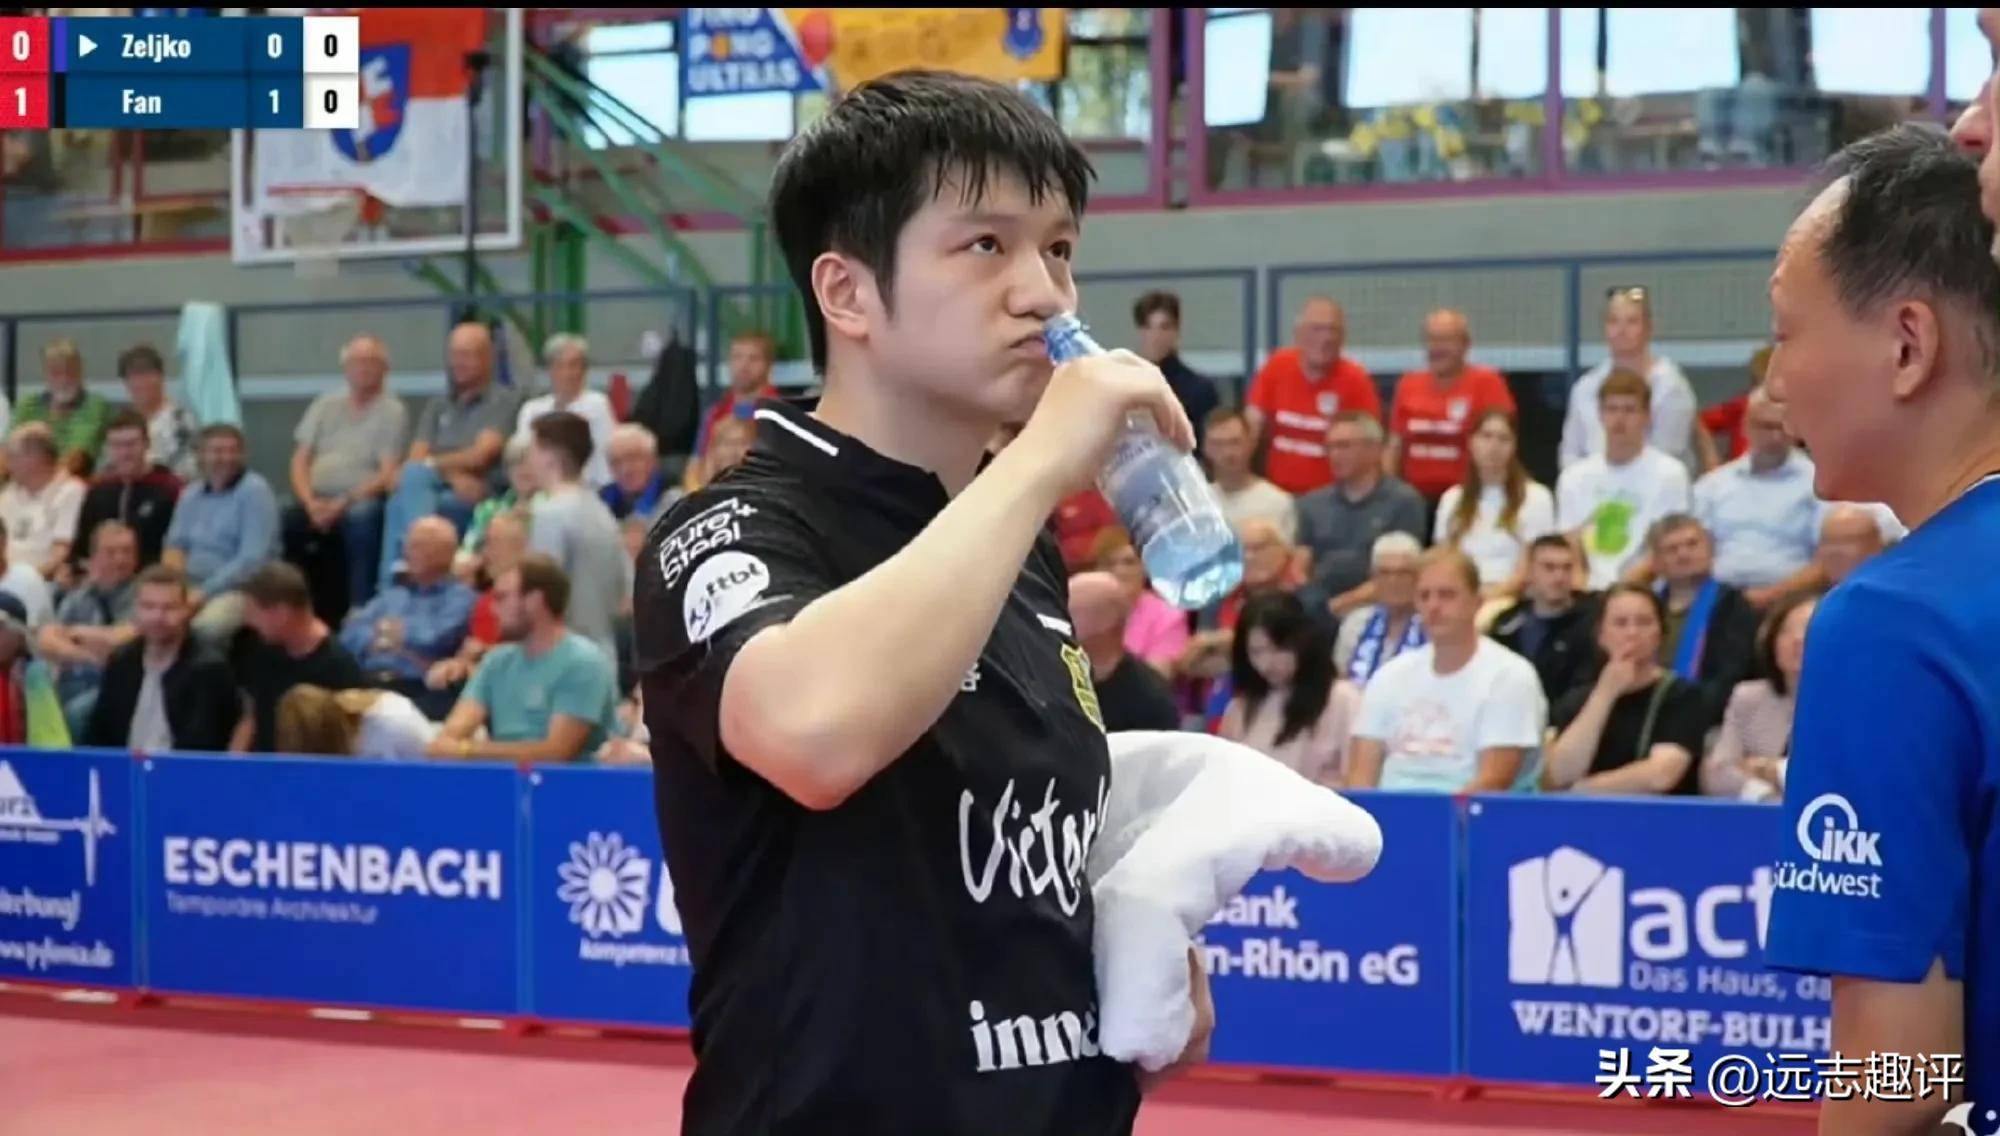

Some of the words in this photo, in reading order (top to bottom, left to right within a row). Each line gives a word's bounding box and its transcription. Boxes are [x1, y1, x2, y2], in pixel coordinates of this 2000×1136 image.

[687, 57, 799, 92] ULTRAS
[164, 836, 501, 899] ESCHENBACH
[1206, 885, 1298, 928] ank
[1359, 944, 1419, 985] eG
[1630, 960, 1688, 993] Das
[1697, 965, 1787, 1002] Haus,
